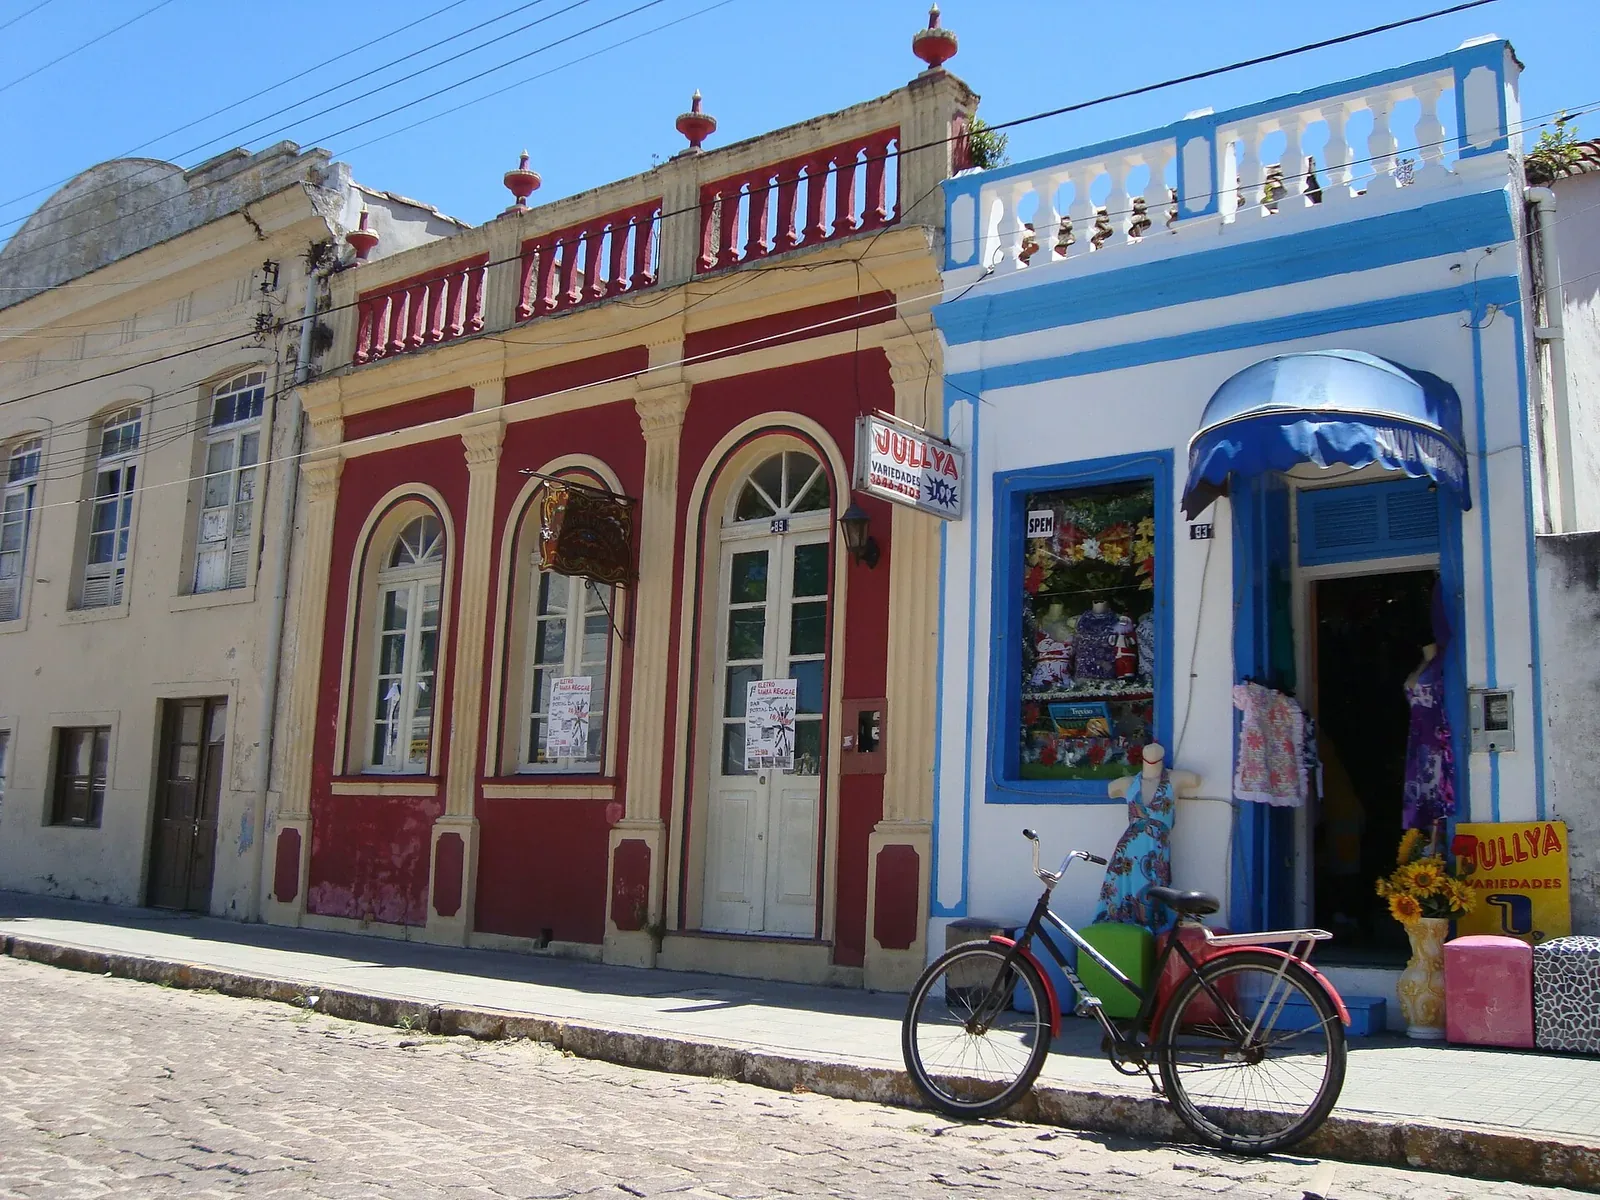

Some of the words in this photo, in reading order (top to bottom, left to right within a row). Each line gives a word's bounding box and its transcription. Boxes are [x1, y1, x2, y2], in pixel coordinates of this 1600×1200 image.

[875, 428, 958, 480] JULLYA
[871, 460, 921, 487] VARIEDADES
[774, 520, 784, 532] 89
[1028, 516, 1053, 533] SPEM
[1195, 525, 1208, 539] 93
[773, 687, 796, 696] REGGAE
